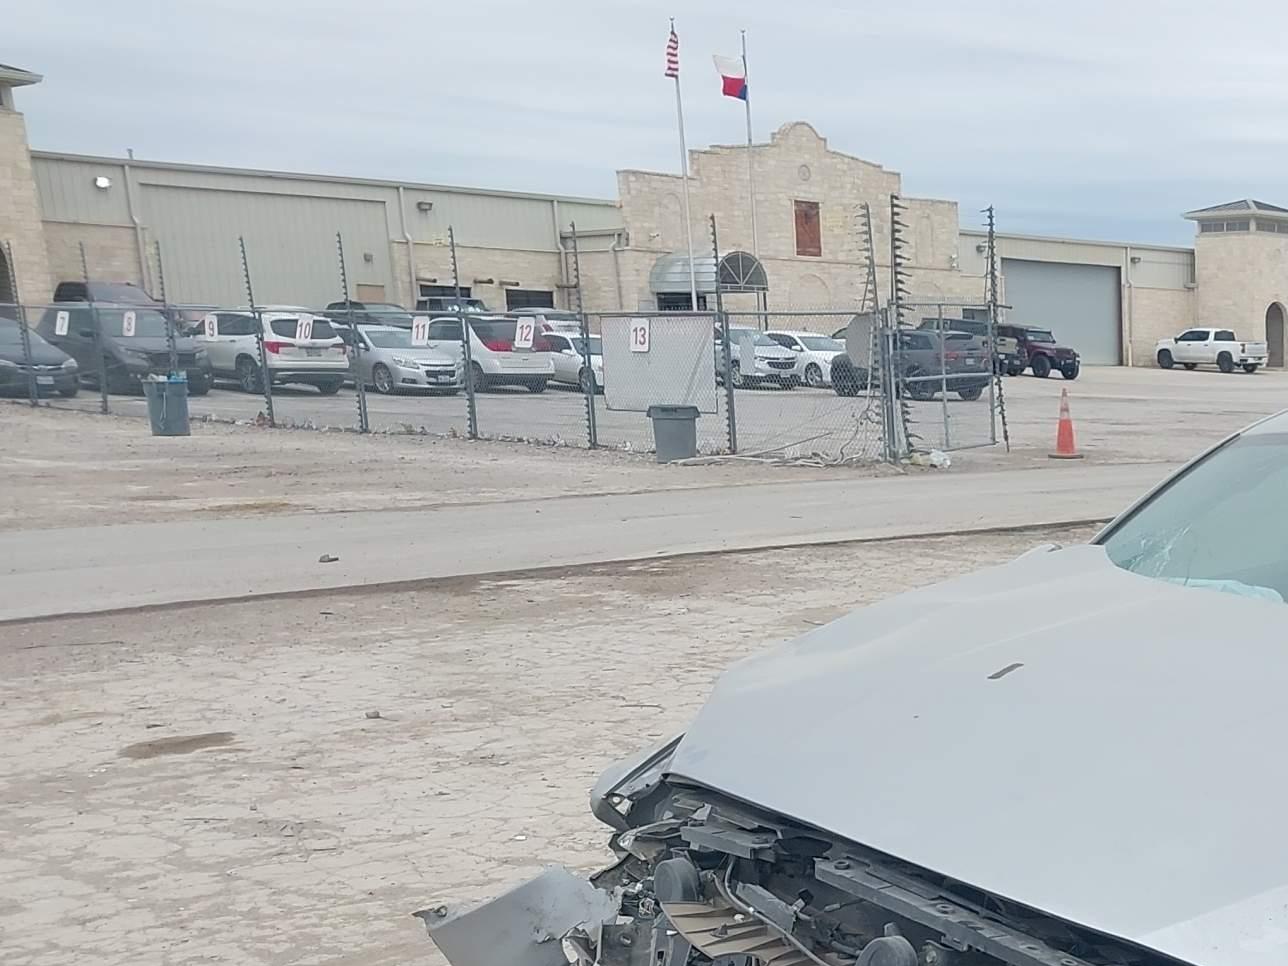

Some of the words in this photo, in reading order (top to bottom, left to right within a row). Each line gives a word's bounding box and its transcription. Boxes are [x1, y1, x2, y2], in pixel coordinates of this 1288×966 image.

[208, 320, 215, 337] 9
[298, 321, 312, 340] 10
[414, 323, 426, 341] 11
[519, 323, 532, 342] 12
[632, 326, 647, 346] 13
